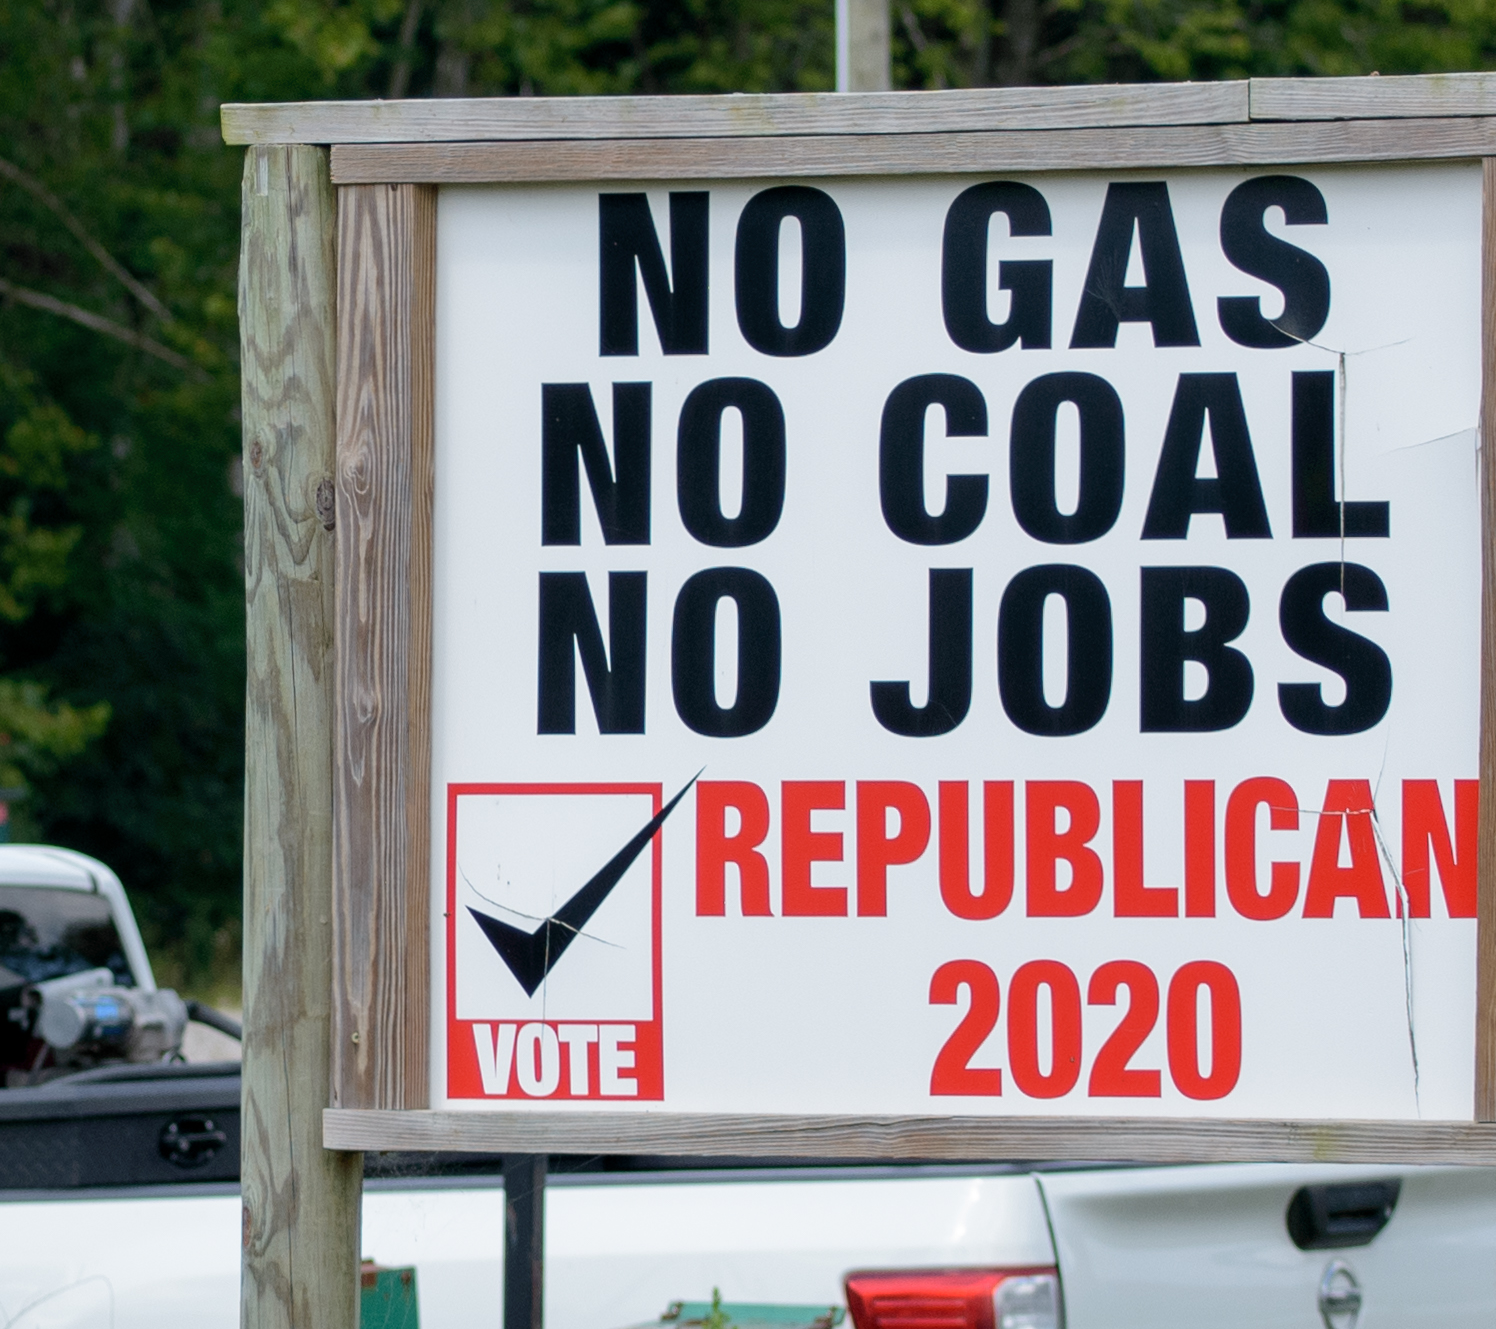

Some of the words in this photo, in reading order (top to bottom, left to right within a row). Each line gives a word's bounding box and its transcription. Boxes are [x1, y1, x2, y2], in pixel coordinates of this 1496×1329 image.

[598, 184, 846, 358] NO
[941, 174, 1332, 354] GAS
[541, 376, 787, 548] NO
[878, 370, 1391, 546] COAL
[536, 565, 782, 739] NO
[869, 560, 1394, 738] JOBS
[695, 776, 1480, 921] REPUBLICAN
[472, 1023, 637, 1097] VOTE
[929, 959, 1243, 1100] 2020
